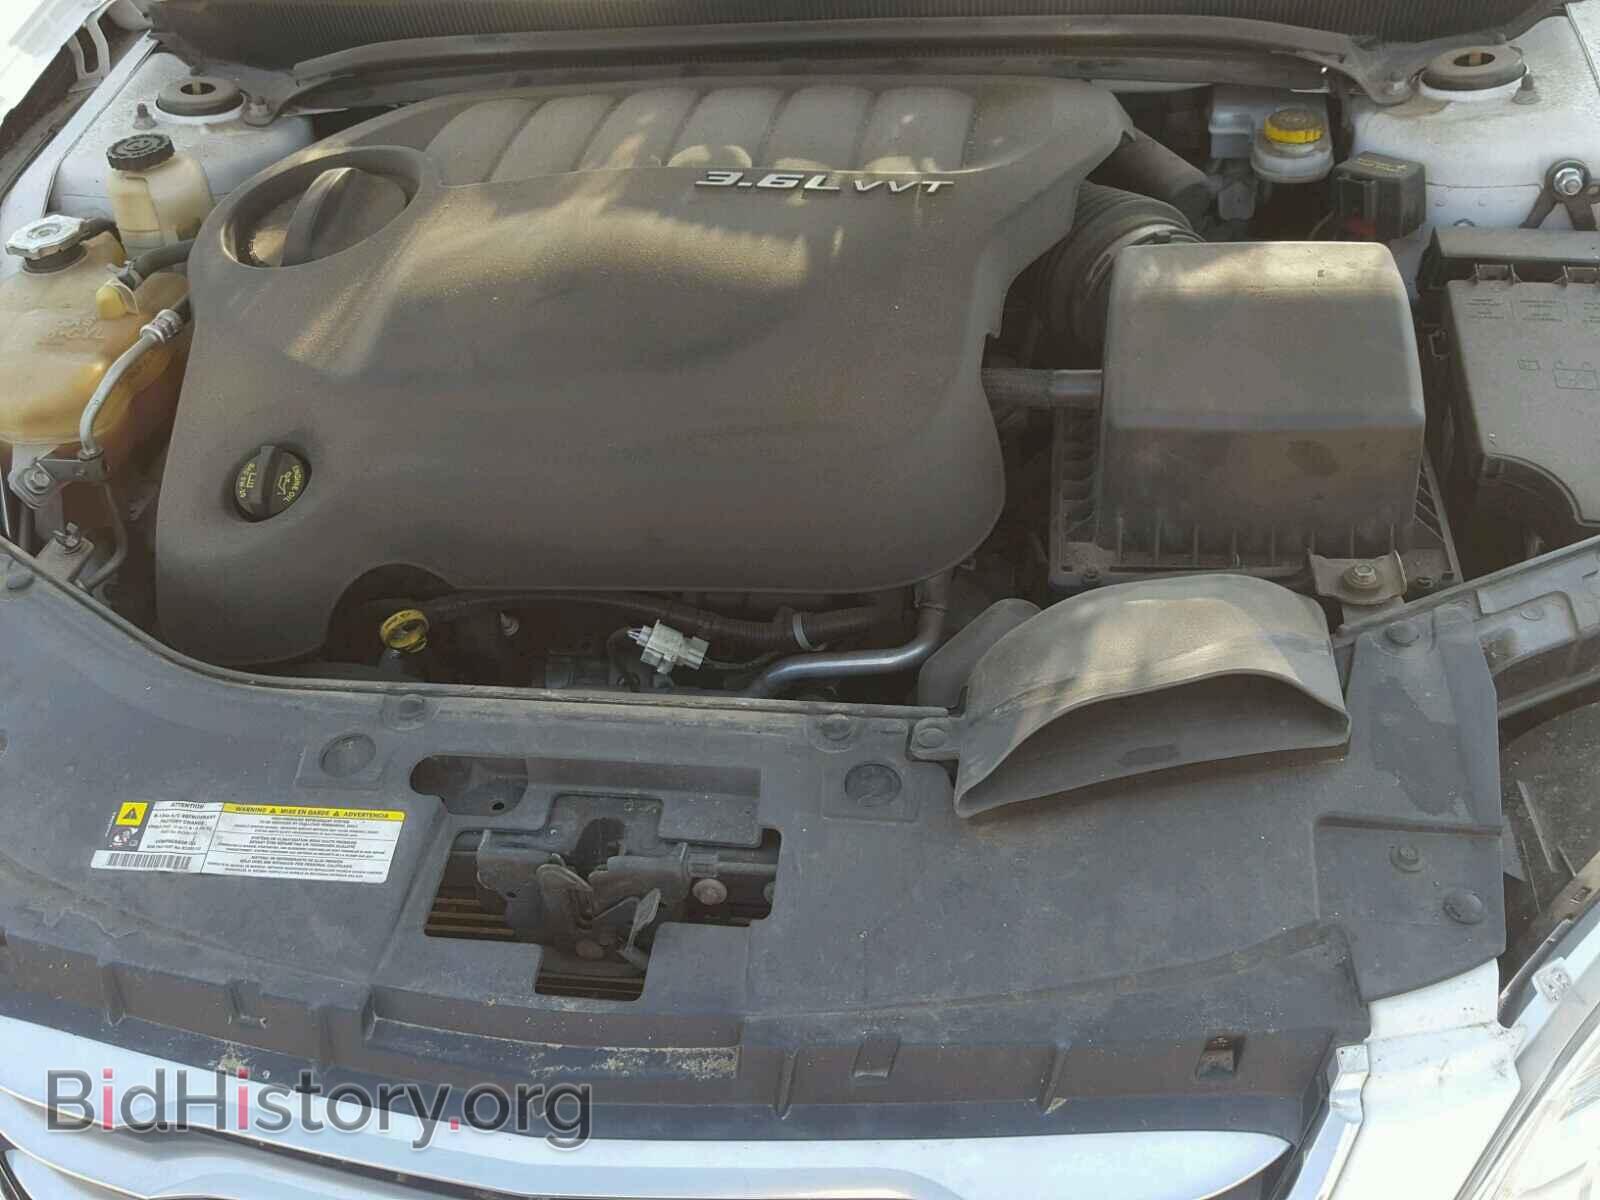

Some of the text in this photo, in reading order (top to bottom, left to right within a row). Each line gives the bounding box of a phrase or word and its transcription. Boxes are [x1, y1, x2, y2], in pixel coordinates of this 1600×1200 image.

[696, 171, 954, 192] 3.6L VVT
[283, 491, 295, 503] OIL
